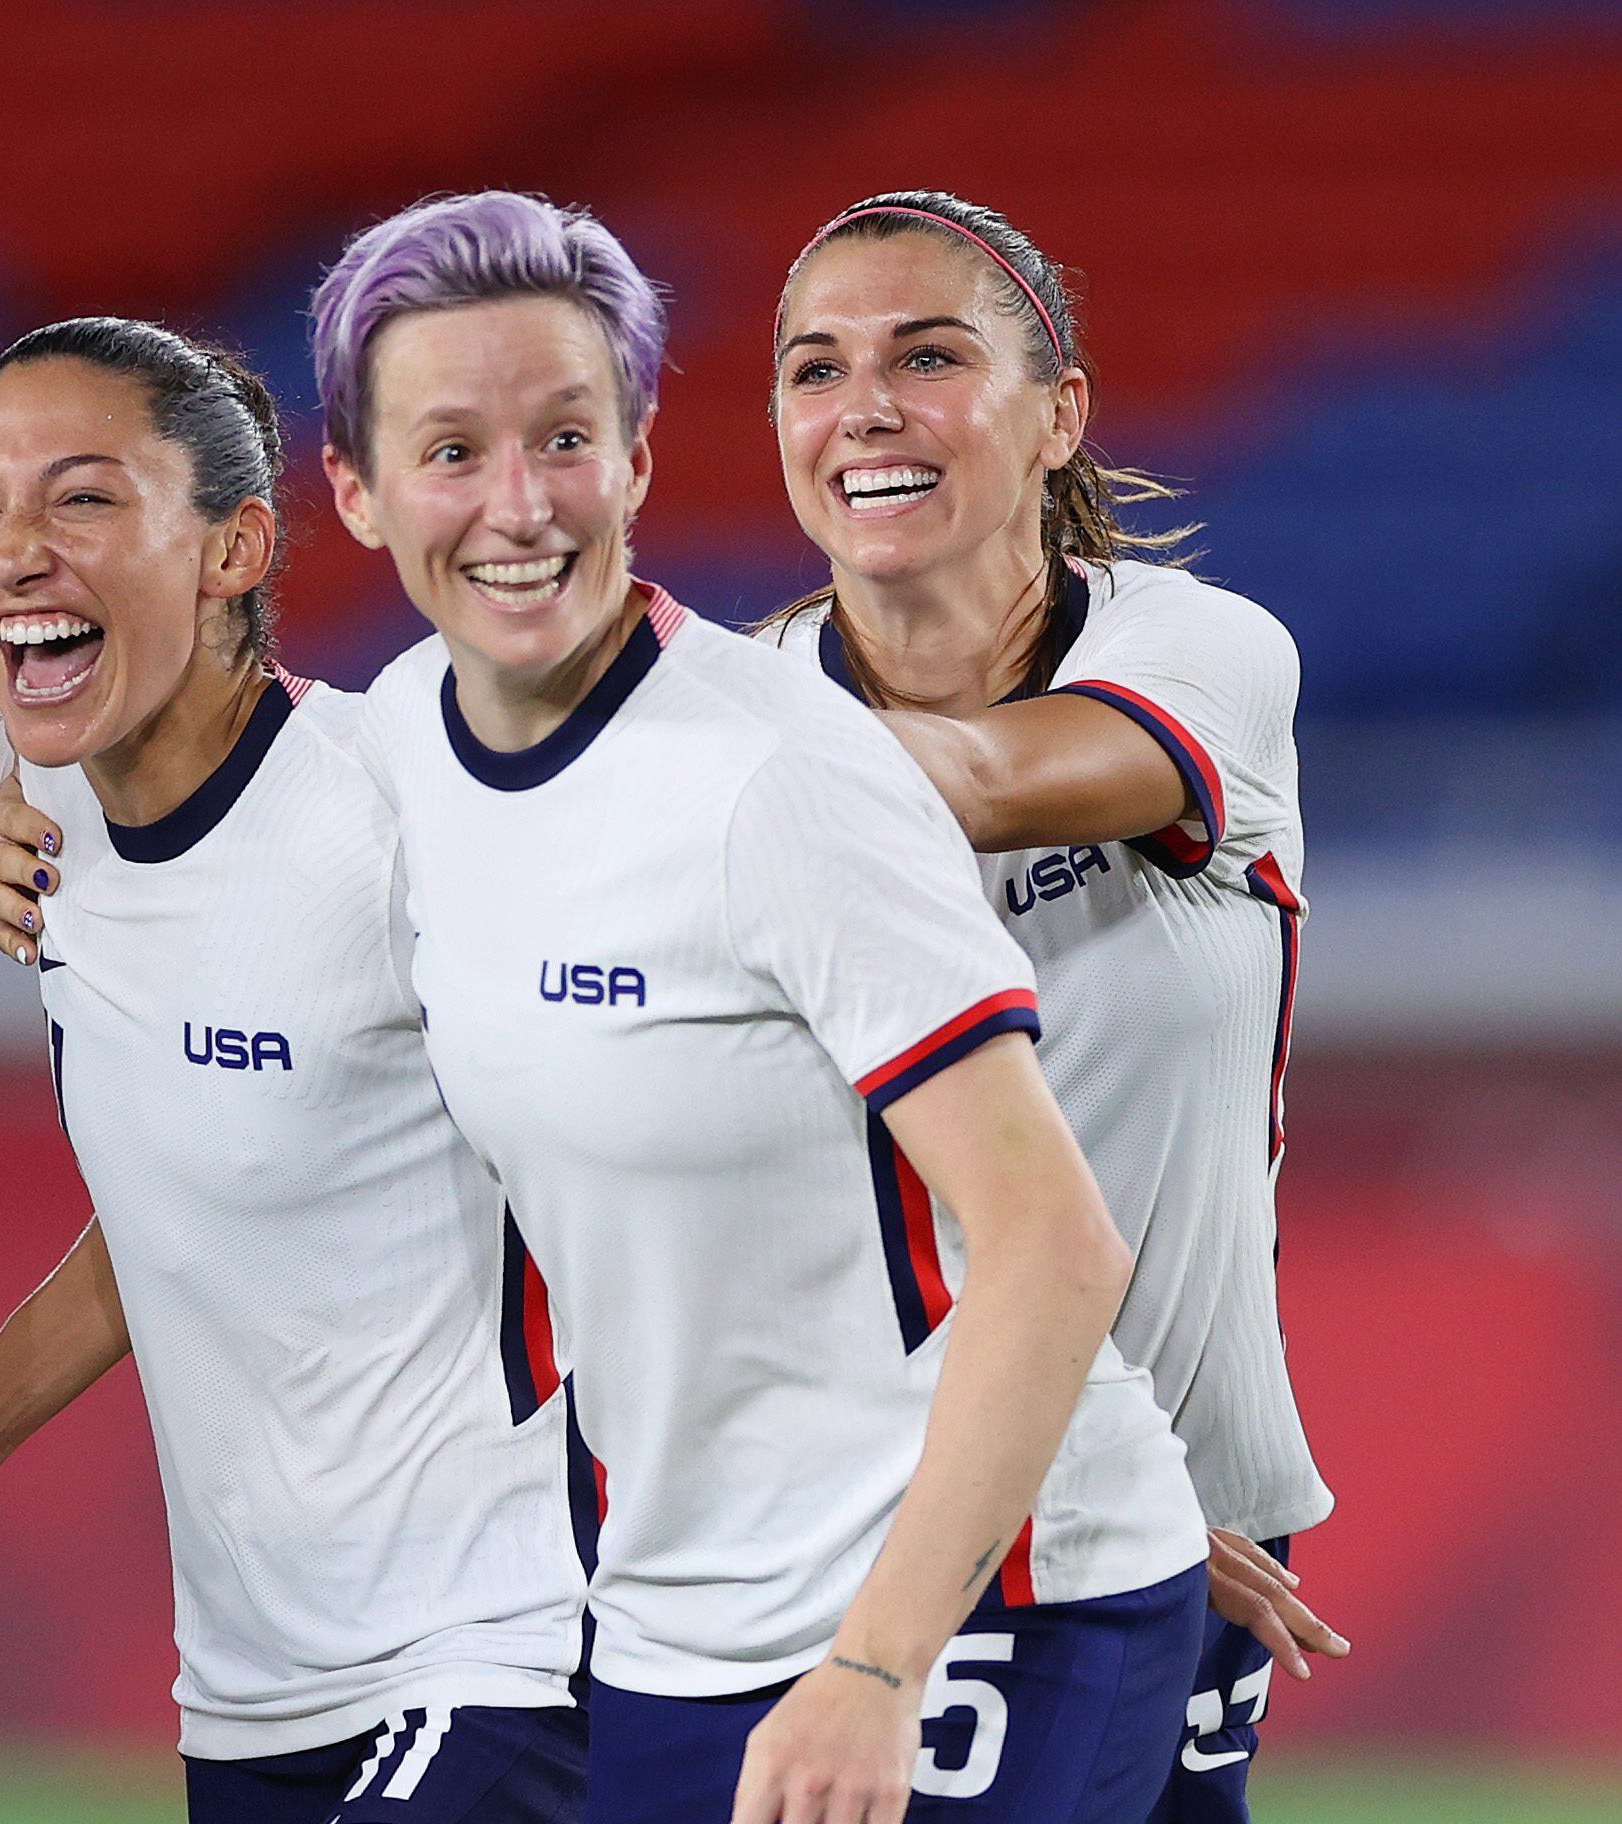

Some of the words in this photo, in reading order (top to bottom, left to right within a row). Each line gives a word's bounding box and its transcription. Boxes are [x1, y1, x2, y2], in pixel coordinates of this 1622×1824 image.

[1005, 844, 1111, 917] USA
[539, 959, 646, 1007] USA
[183, 1021, 293, 1071] USA
